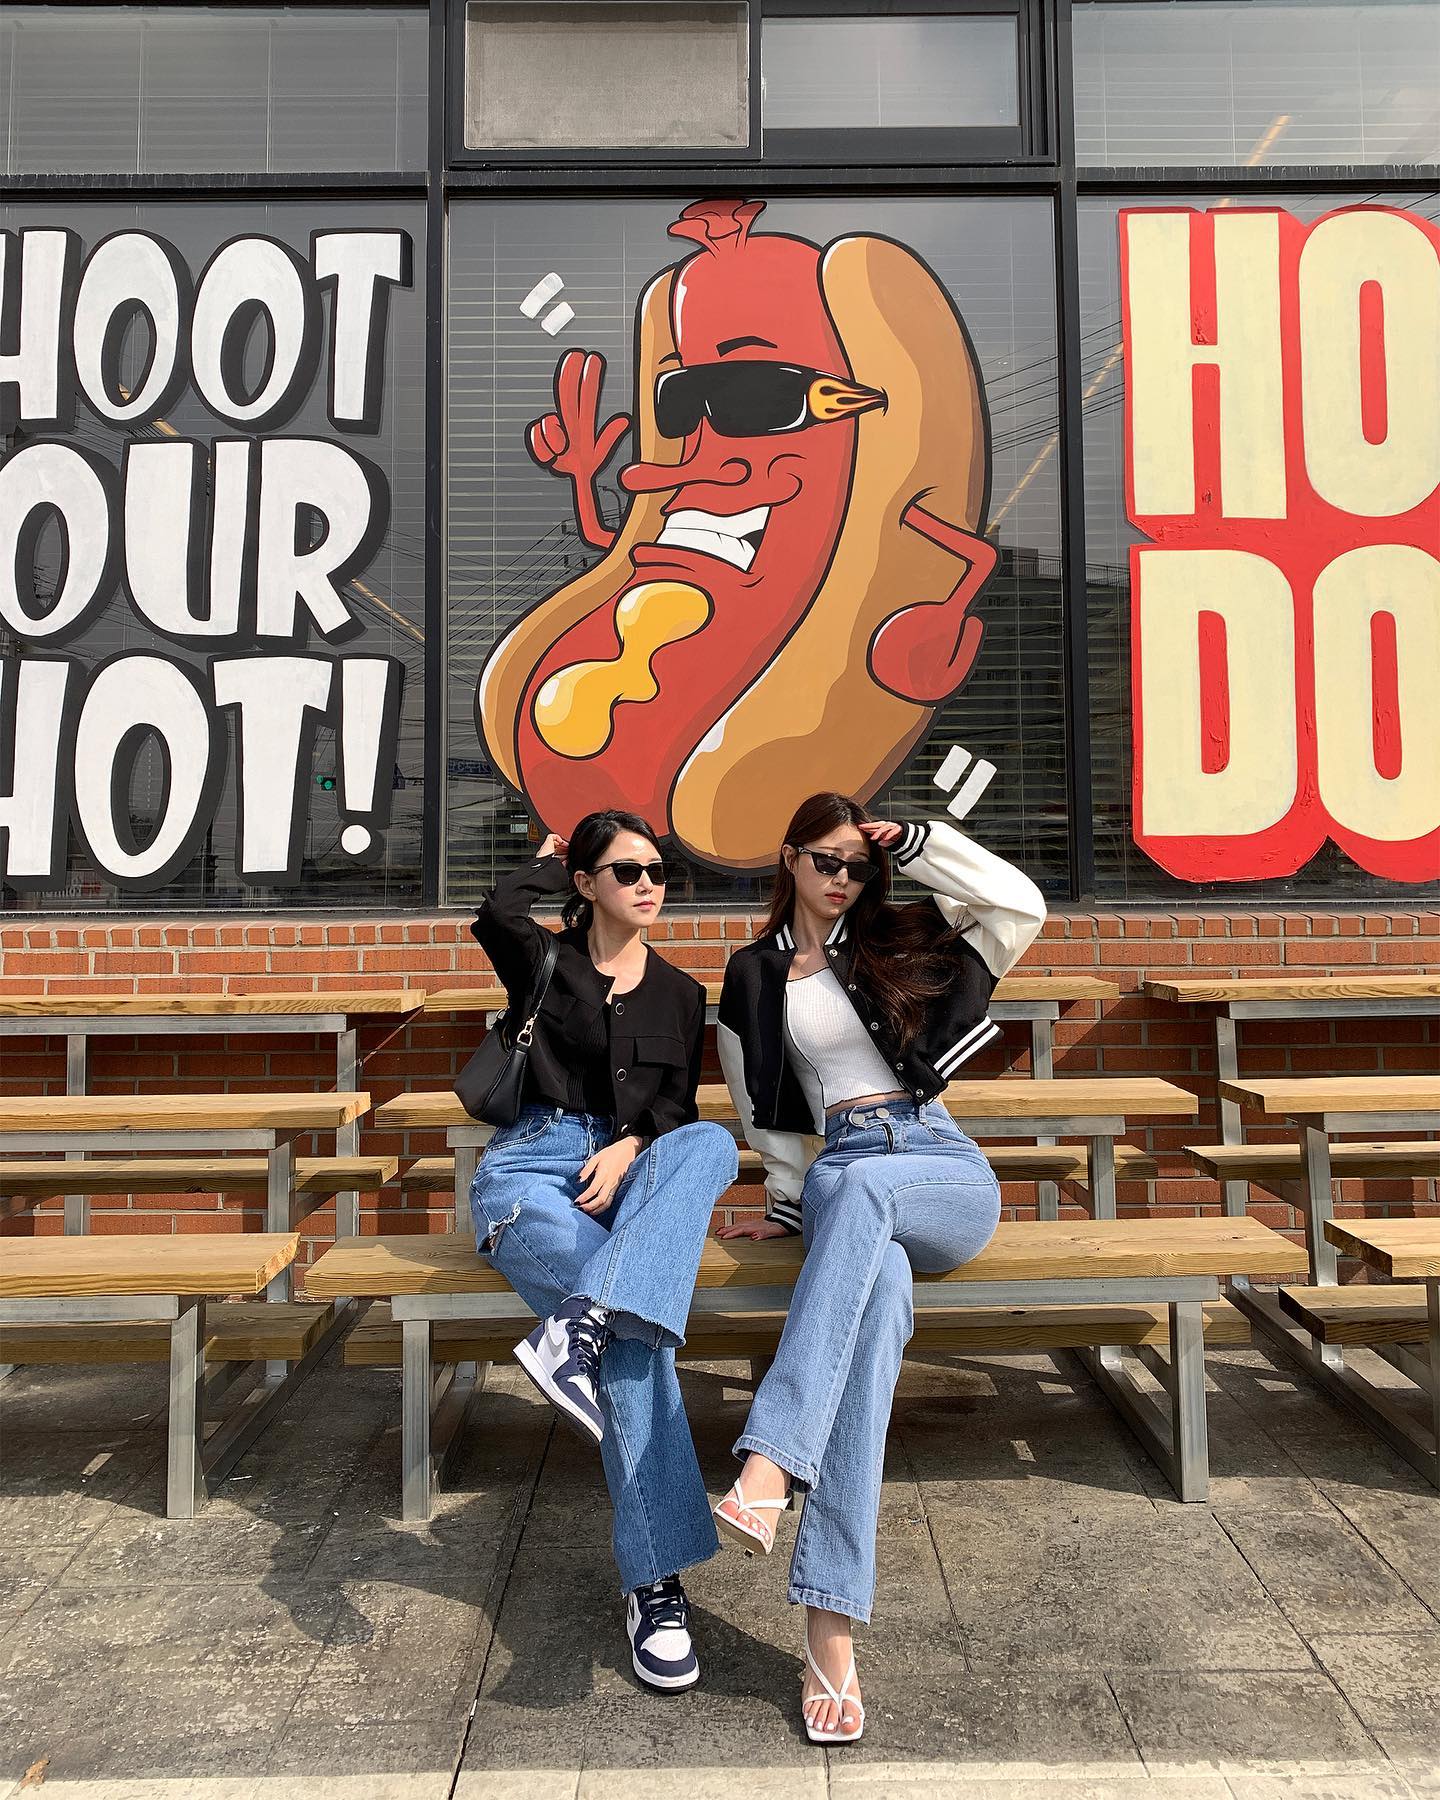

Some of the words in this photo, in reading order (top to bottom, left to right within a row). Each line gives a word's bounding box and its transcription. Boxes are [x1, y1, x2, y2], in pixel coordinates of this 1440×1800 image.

[1126, 210, 1440, 519] HO
[0, 438, 372, 638] OUR
[1140, 543, 1440, 841] DO
